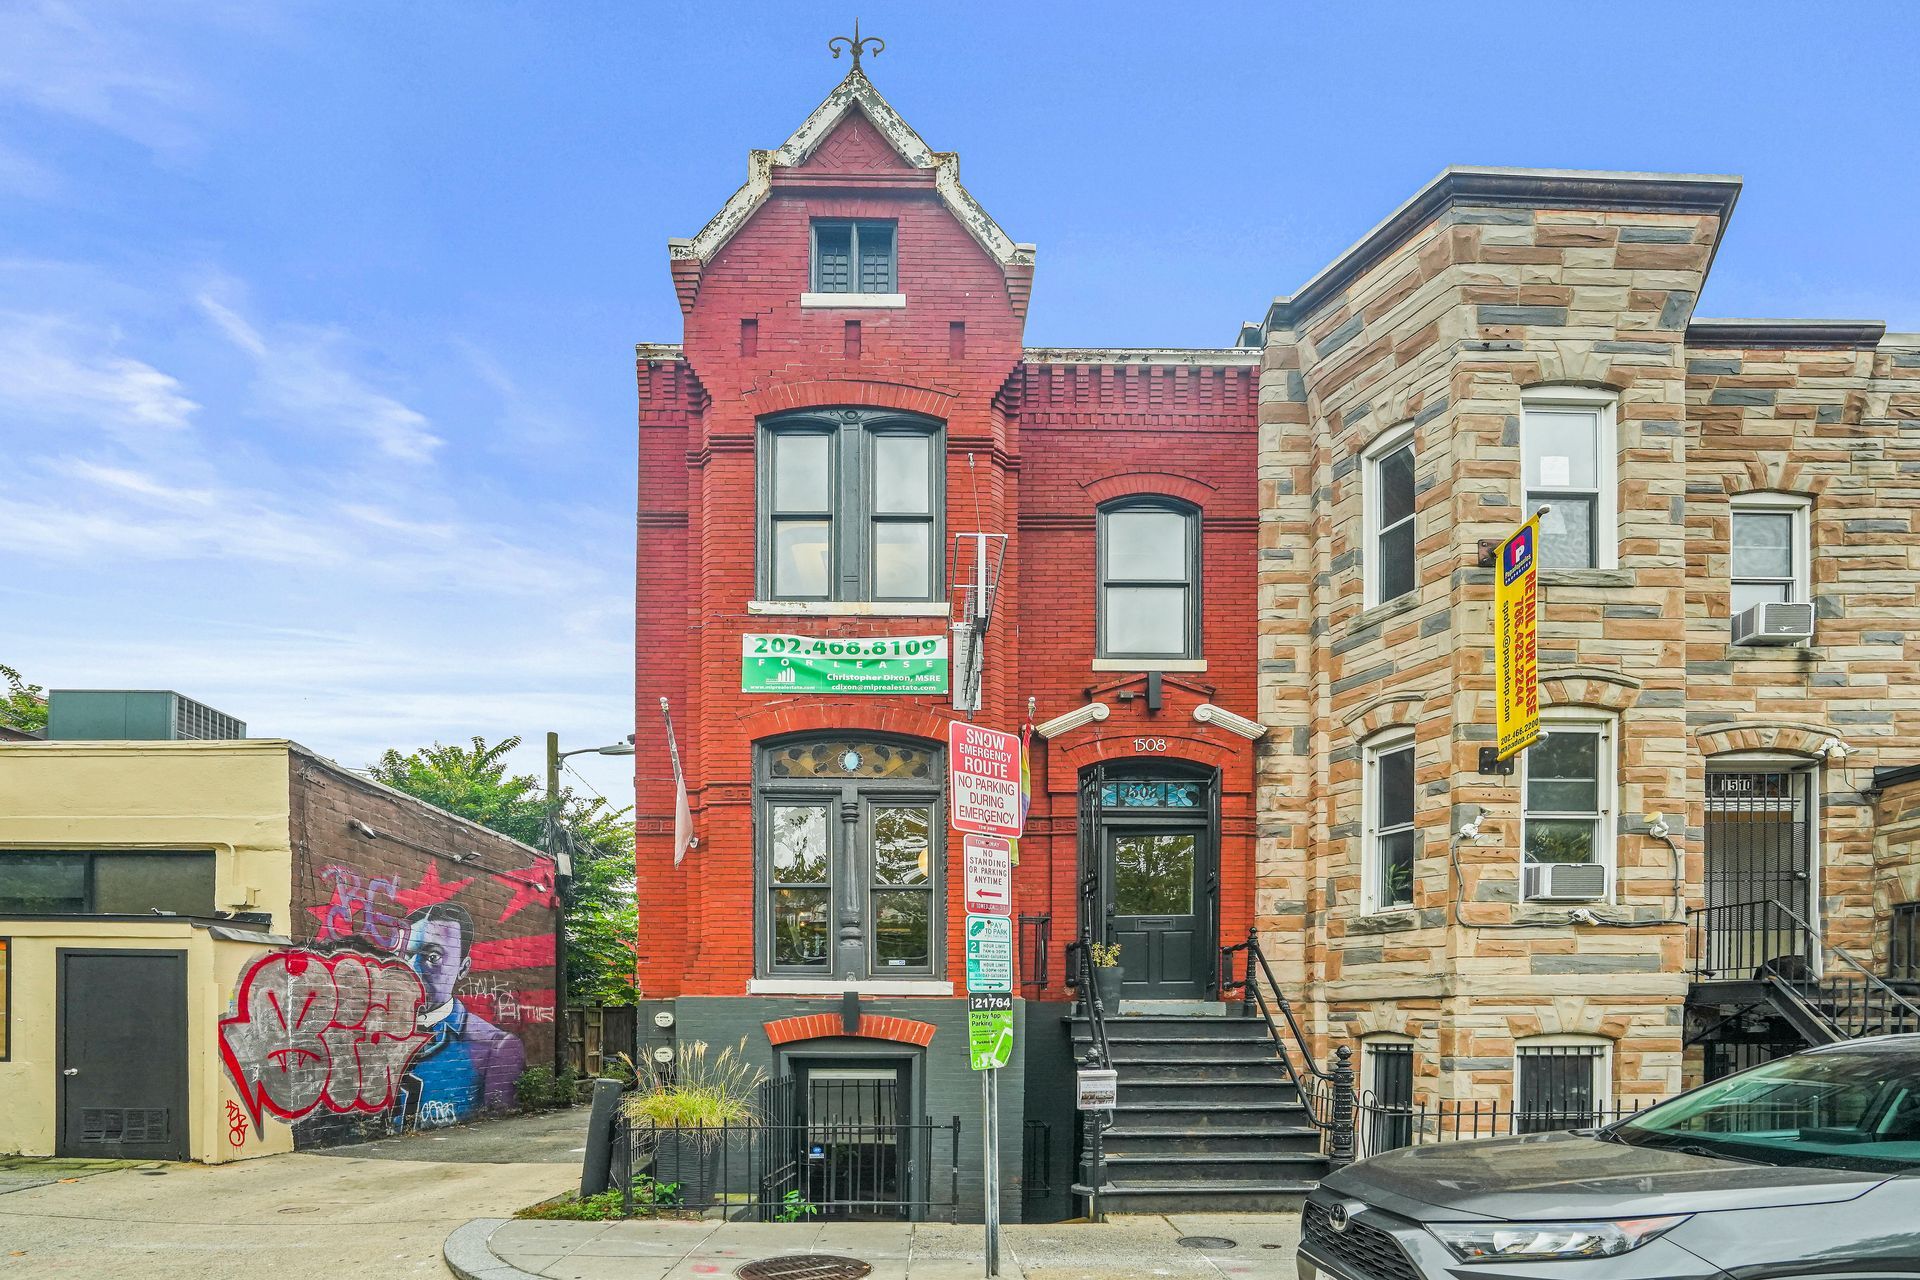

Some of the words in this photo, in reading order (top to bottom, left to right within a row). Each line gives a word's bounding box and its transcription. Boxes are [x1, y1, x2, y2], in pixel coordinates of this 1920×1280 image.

[1525, 569, 1536, 628] RETAIL
[754, 638, 936, 656] 202.468.8109
[1514, 596, 1524, 708] 786.423.2244
[1525, 629, 1536, 667] FOR
[1502, 600, 1511, 722] spotts@papadop.com
[826, 674, 882, 684] Christopher
[884, 674, 914, 682] Dixon,
[1526, 668, 1536, 718] LEASE
[966, 728, 1005, 750] SNOW
[1133, 738, 1166, 752] 1508
[960, 744, 1012, 763] EMERGENCY
[964, 756, 1008, 778] ROUTE
[958, 774, 972, 788] NO
[976, 778, 1014, 796] PARKING
[1724, 780, 1752, 790] 1510
[970, 792, 1004, 808] DURING
[960, 806, 1014, 825] EMERGENCY
[970, 856, 1006, 868] STANDING
[982, 848, 993, 858] NO
[969, 866, 977, 874] OR
[980, 867, 1007, 877] PARKING
[974, 876, 1002, 886] ANYTIME
[971, 942, 976, 951] 2
[975, 998, 1010, 1008] 21764
